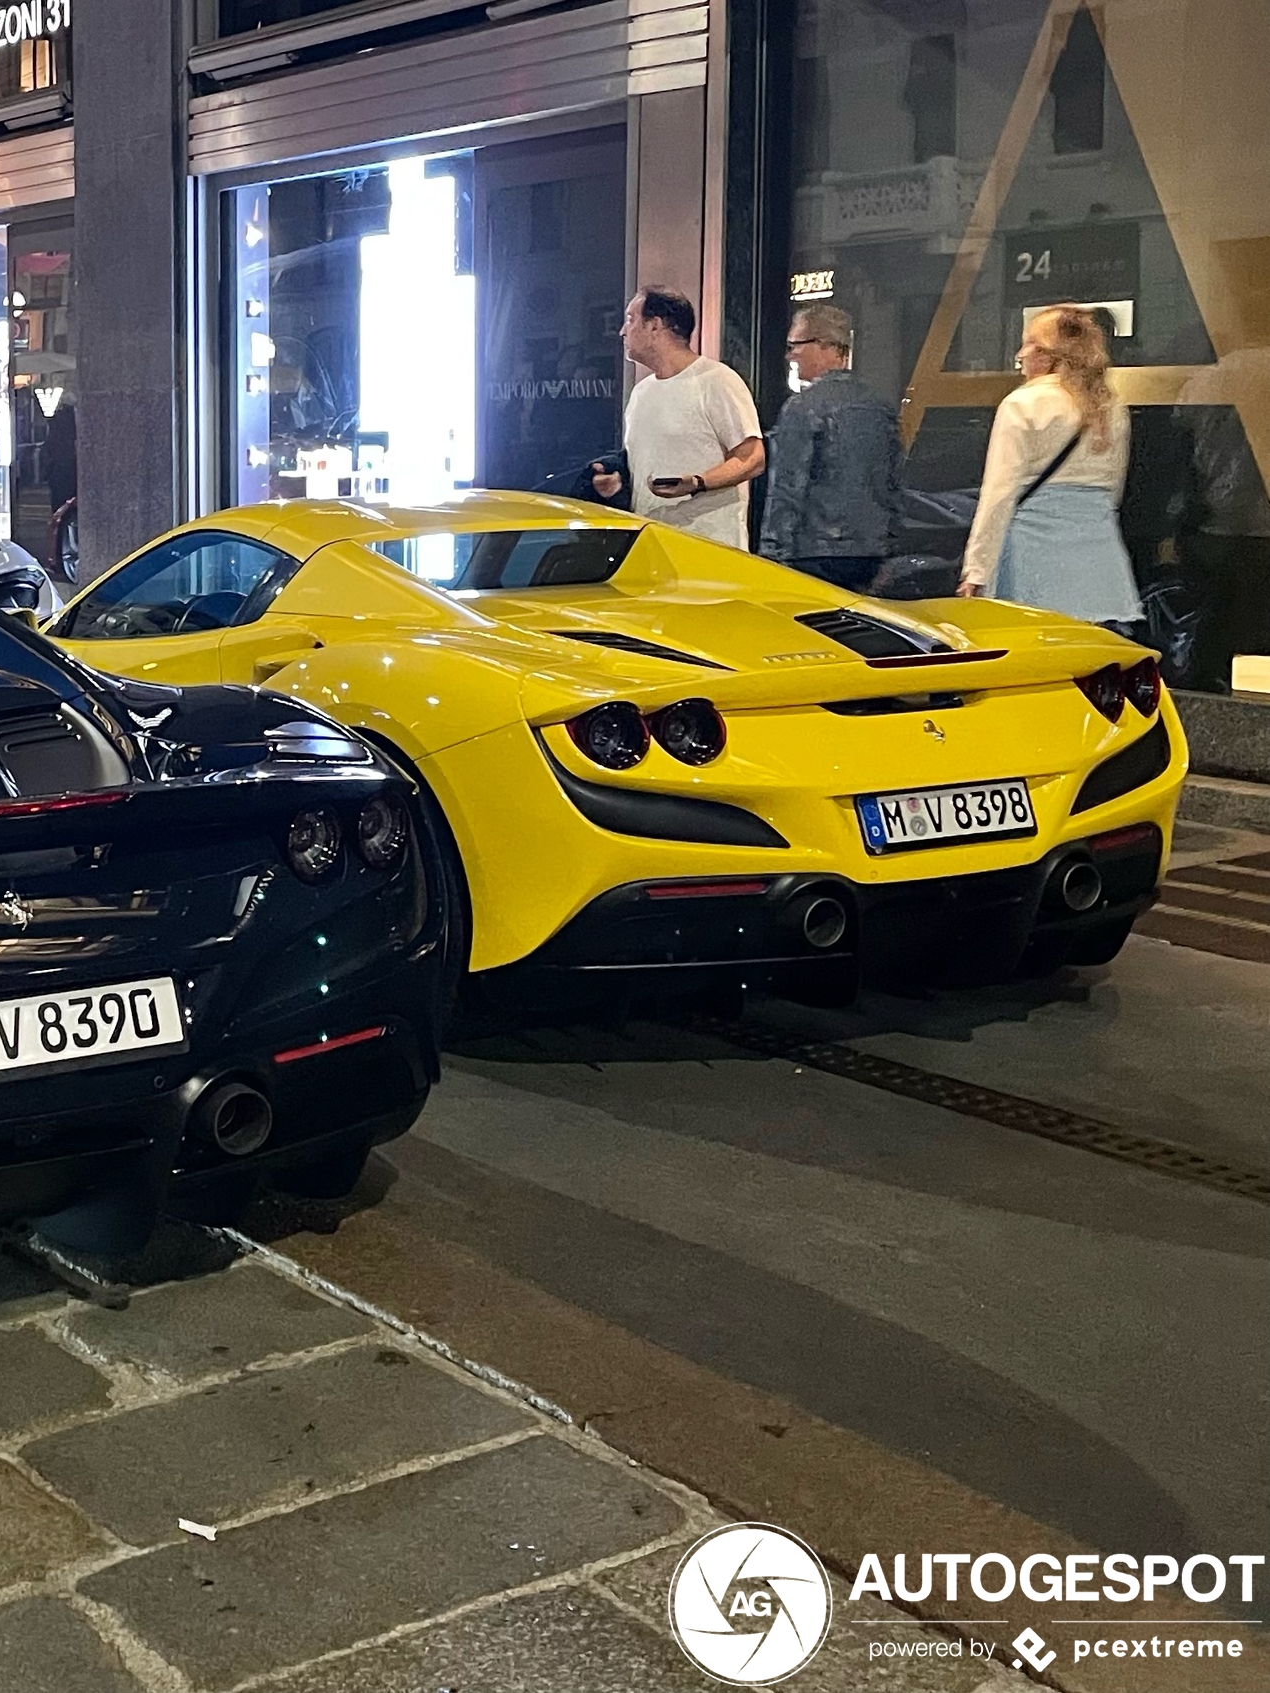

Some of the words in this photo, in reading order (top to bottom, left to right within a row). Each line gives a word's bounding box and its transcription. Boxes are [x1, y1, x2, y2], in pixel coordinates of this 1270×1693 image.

[46, 0, 71, 33] 31
[1016, 250, 1051, 282] 24
[489, 380, 545, 400] EMPORIO
[562, 379, 612, 398] ARMANI
[881, 800, 908, 838] M
[923, 796, 943, 832] V
[952, 787, 1028, 829] 8398
[37, 988, 161, 1053] 8390
